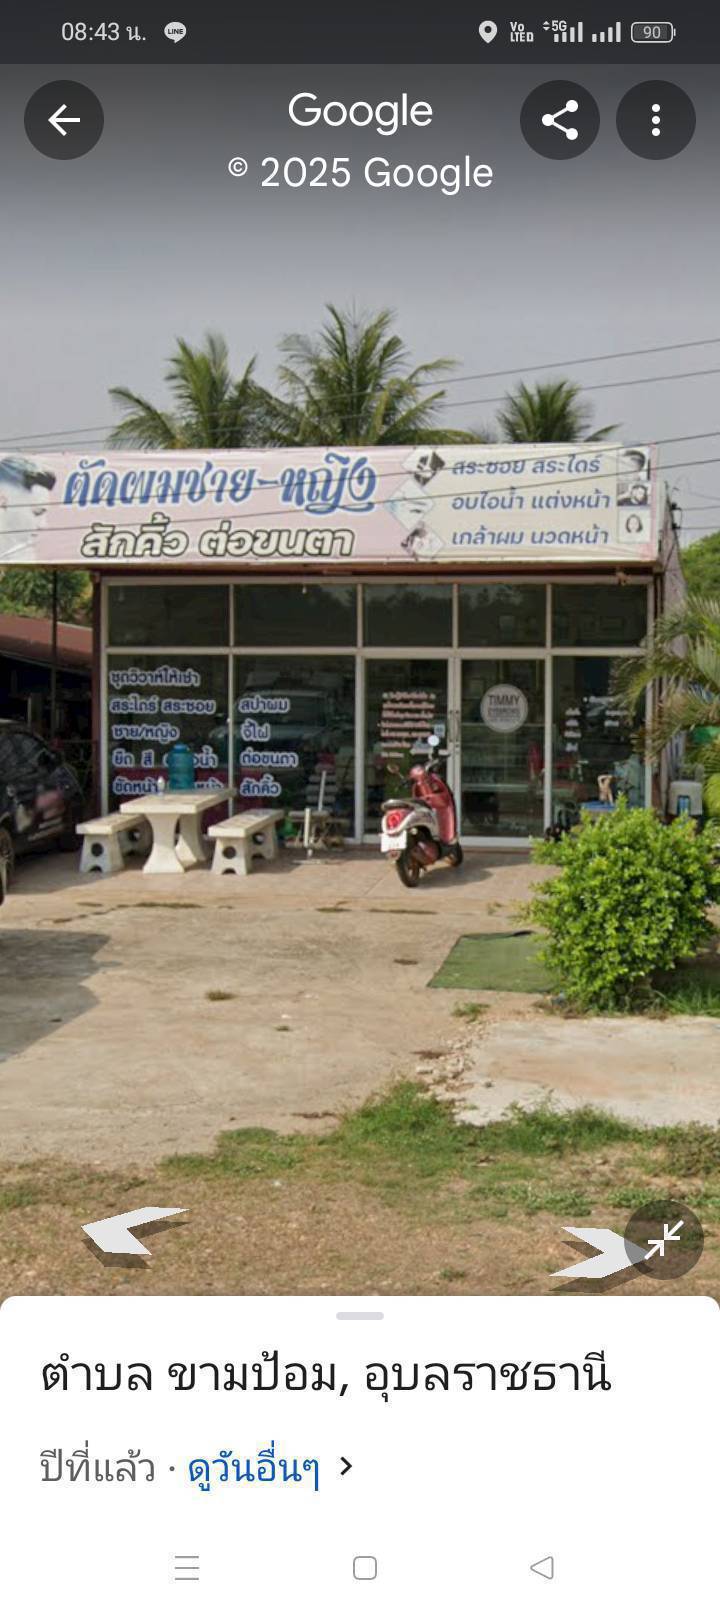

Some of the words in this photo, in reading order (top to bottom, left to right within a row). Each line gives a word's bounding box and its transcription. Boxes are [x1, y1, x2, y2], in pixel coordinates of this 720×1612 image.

[63, 452, 377, 516] ตัดผมชาย-หญิง
[452, 487, 524, 511] อบไอน้ำ
[531, 487, 611, 511] แต่งหน้า
[80, 511, 189, 558] สักคิ้ว
[197, 519, 355, 558] ต่อขนตา
[452, 525, 525, 546] เกล้าผม
[531, 525, 609, 545] นวดหน้า
[240, 774, 281, 797] สักคิ้ว
